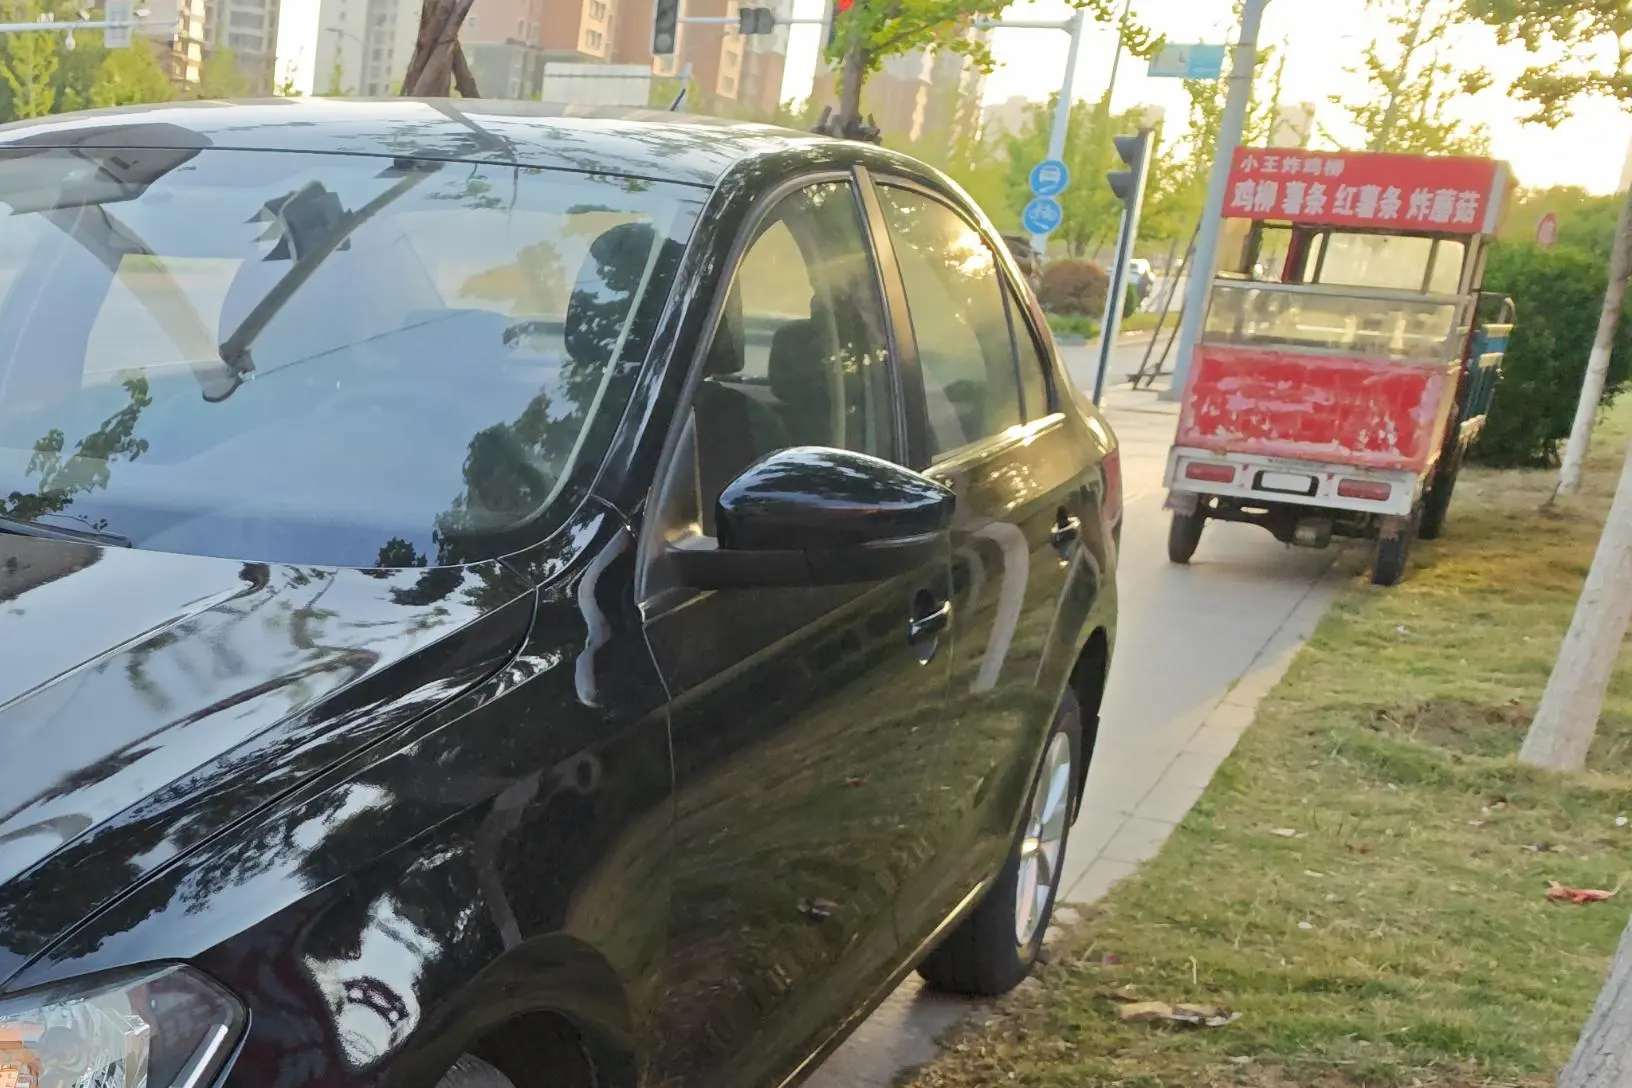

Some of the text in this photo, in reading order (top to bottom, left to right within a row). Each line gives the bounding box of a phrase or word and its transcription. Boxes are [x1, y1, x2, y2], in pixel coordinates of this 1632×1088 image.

[1240, 154, 1345, 177] 小王炸鸡柳
[1231, 179, 1481, 224] 鸡柳 薯条 红薯条 炸蘑菇
